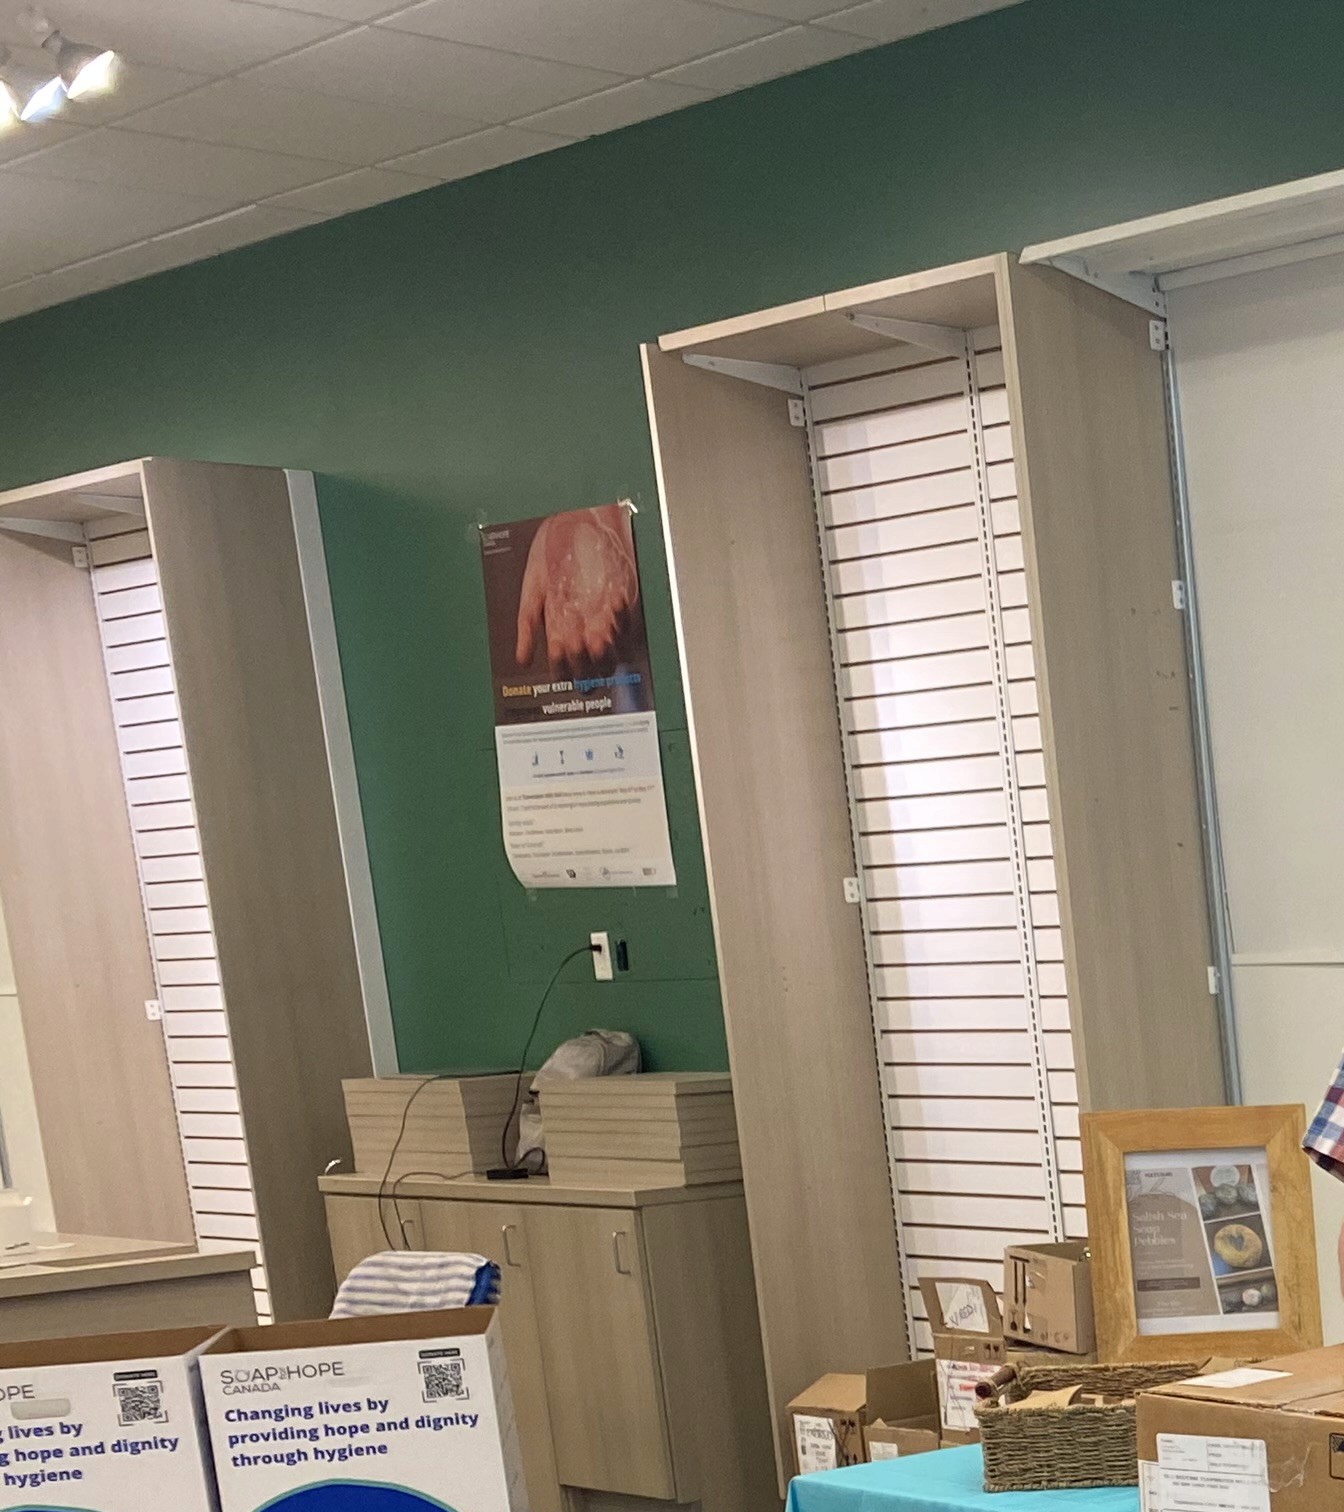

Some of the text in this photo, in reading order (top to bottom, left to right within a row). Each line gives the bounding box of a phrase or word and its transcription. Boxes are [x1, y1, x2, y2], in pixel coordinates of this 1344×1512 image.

[502, 685, 532, 697] Donate
[532, 682, 550, 697] your
[552, 680, 573, 692] extra
[542, 698, 584, 715] vulnerable
[585, 696, 612, 713] people
[222, 1382, 281, 1396] CANADA
[225, 1398, 389, 1423] Changing lives by
[9, 1421, 82, 1440] lives by
[228, 1412, 479, 1448] providing hope and dignity
[15, 1436, 179, 1463] hope and dignity
[231, 1442, 388, 1468] through hygiene
[4, 1468, 83, 1488] hygiene
